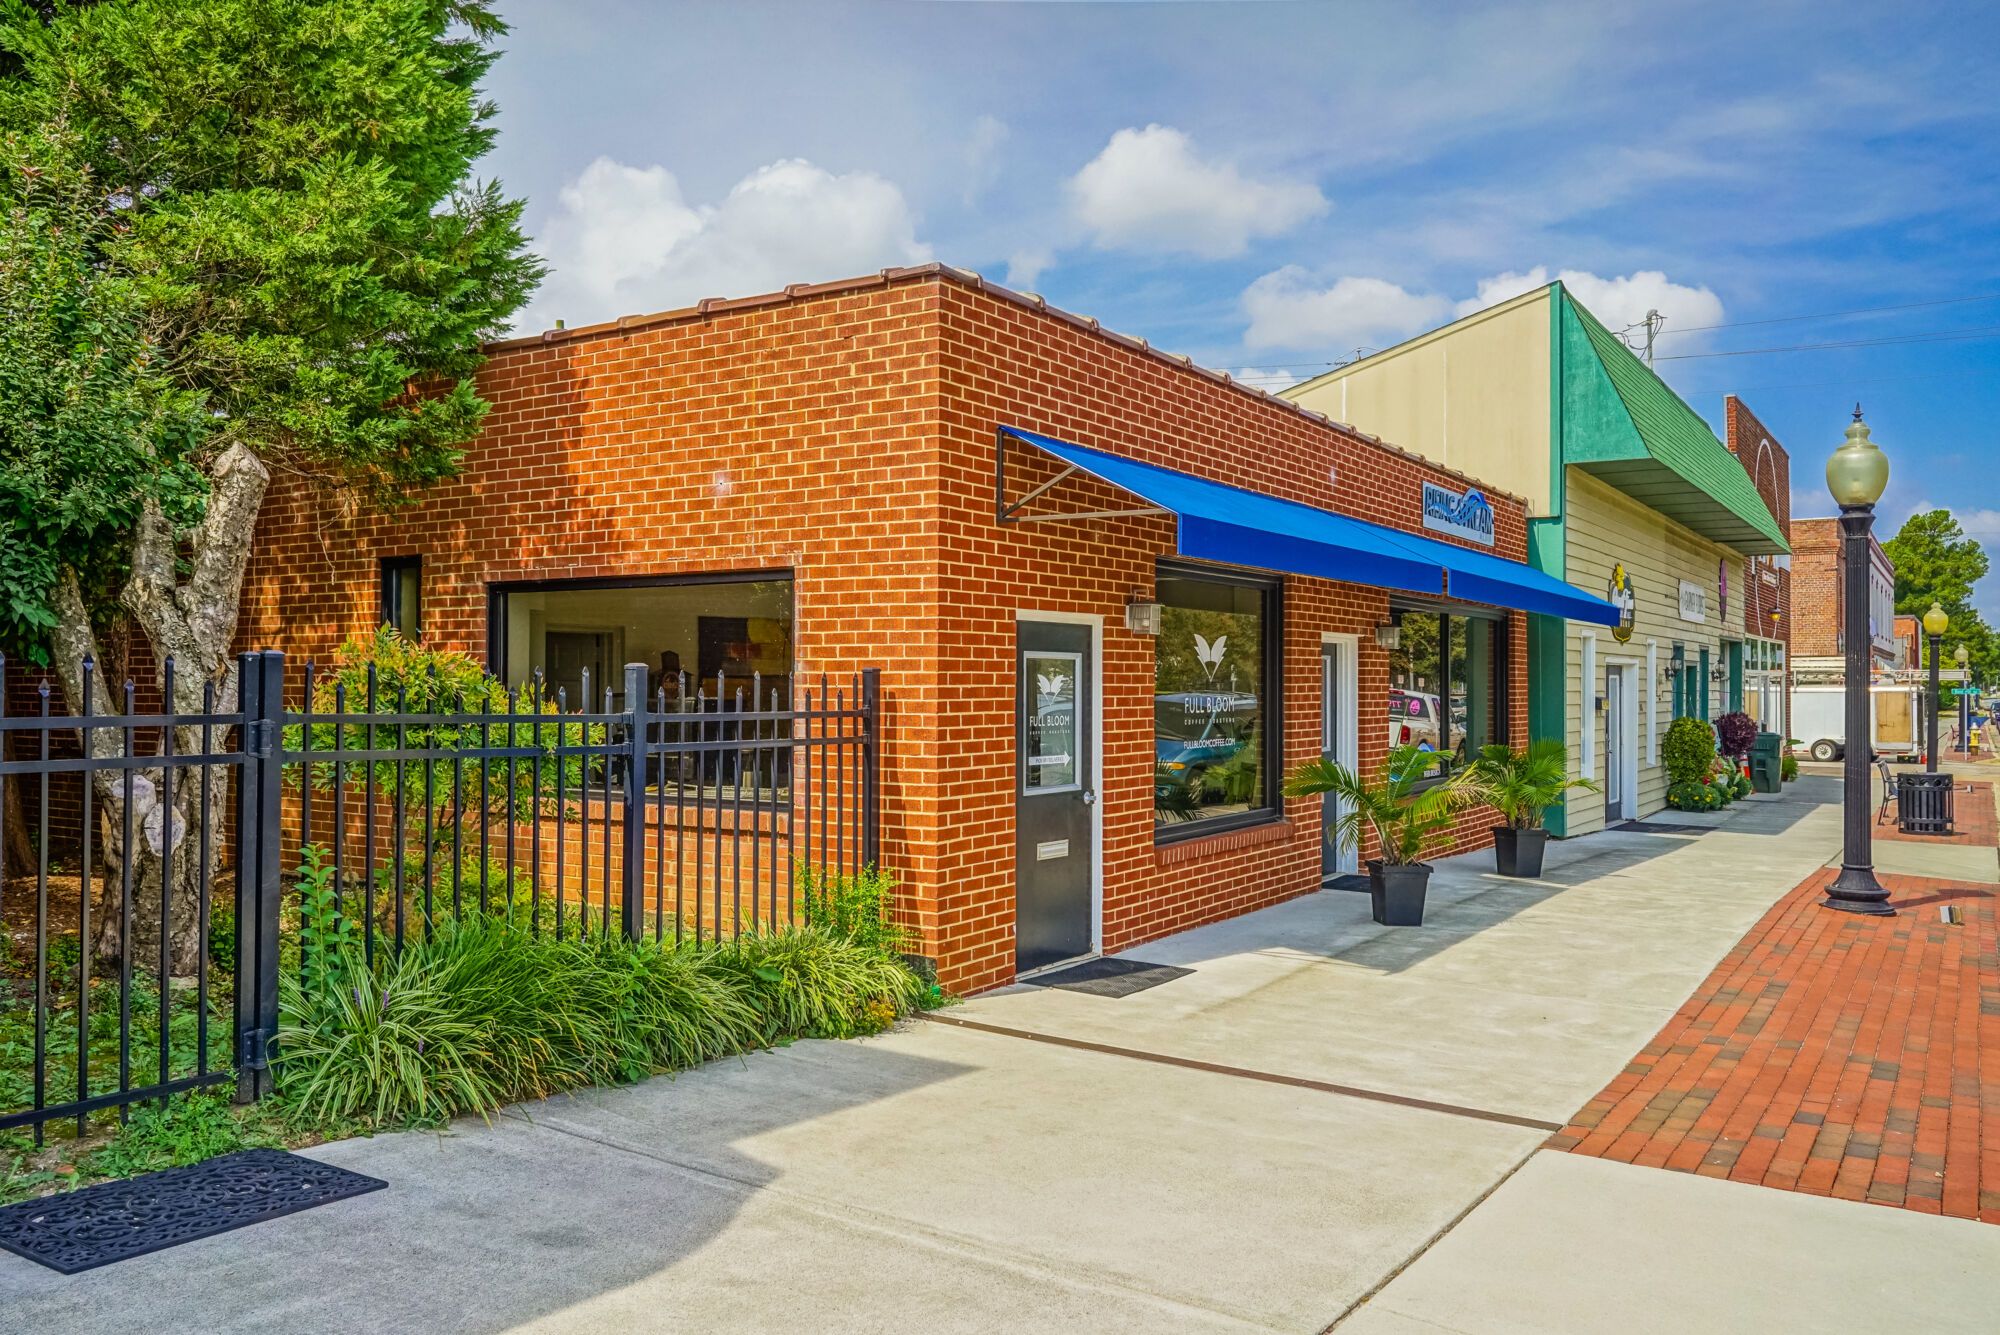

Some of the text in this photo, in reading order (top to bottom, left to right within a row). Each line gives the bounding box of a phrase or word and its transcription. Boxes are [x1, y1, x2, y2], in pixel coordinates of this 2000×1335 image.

[1184, 697, 1235, 714] FULL BLOOM
[1029, 715, 1070, 727] FULL BLOOM
